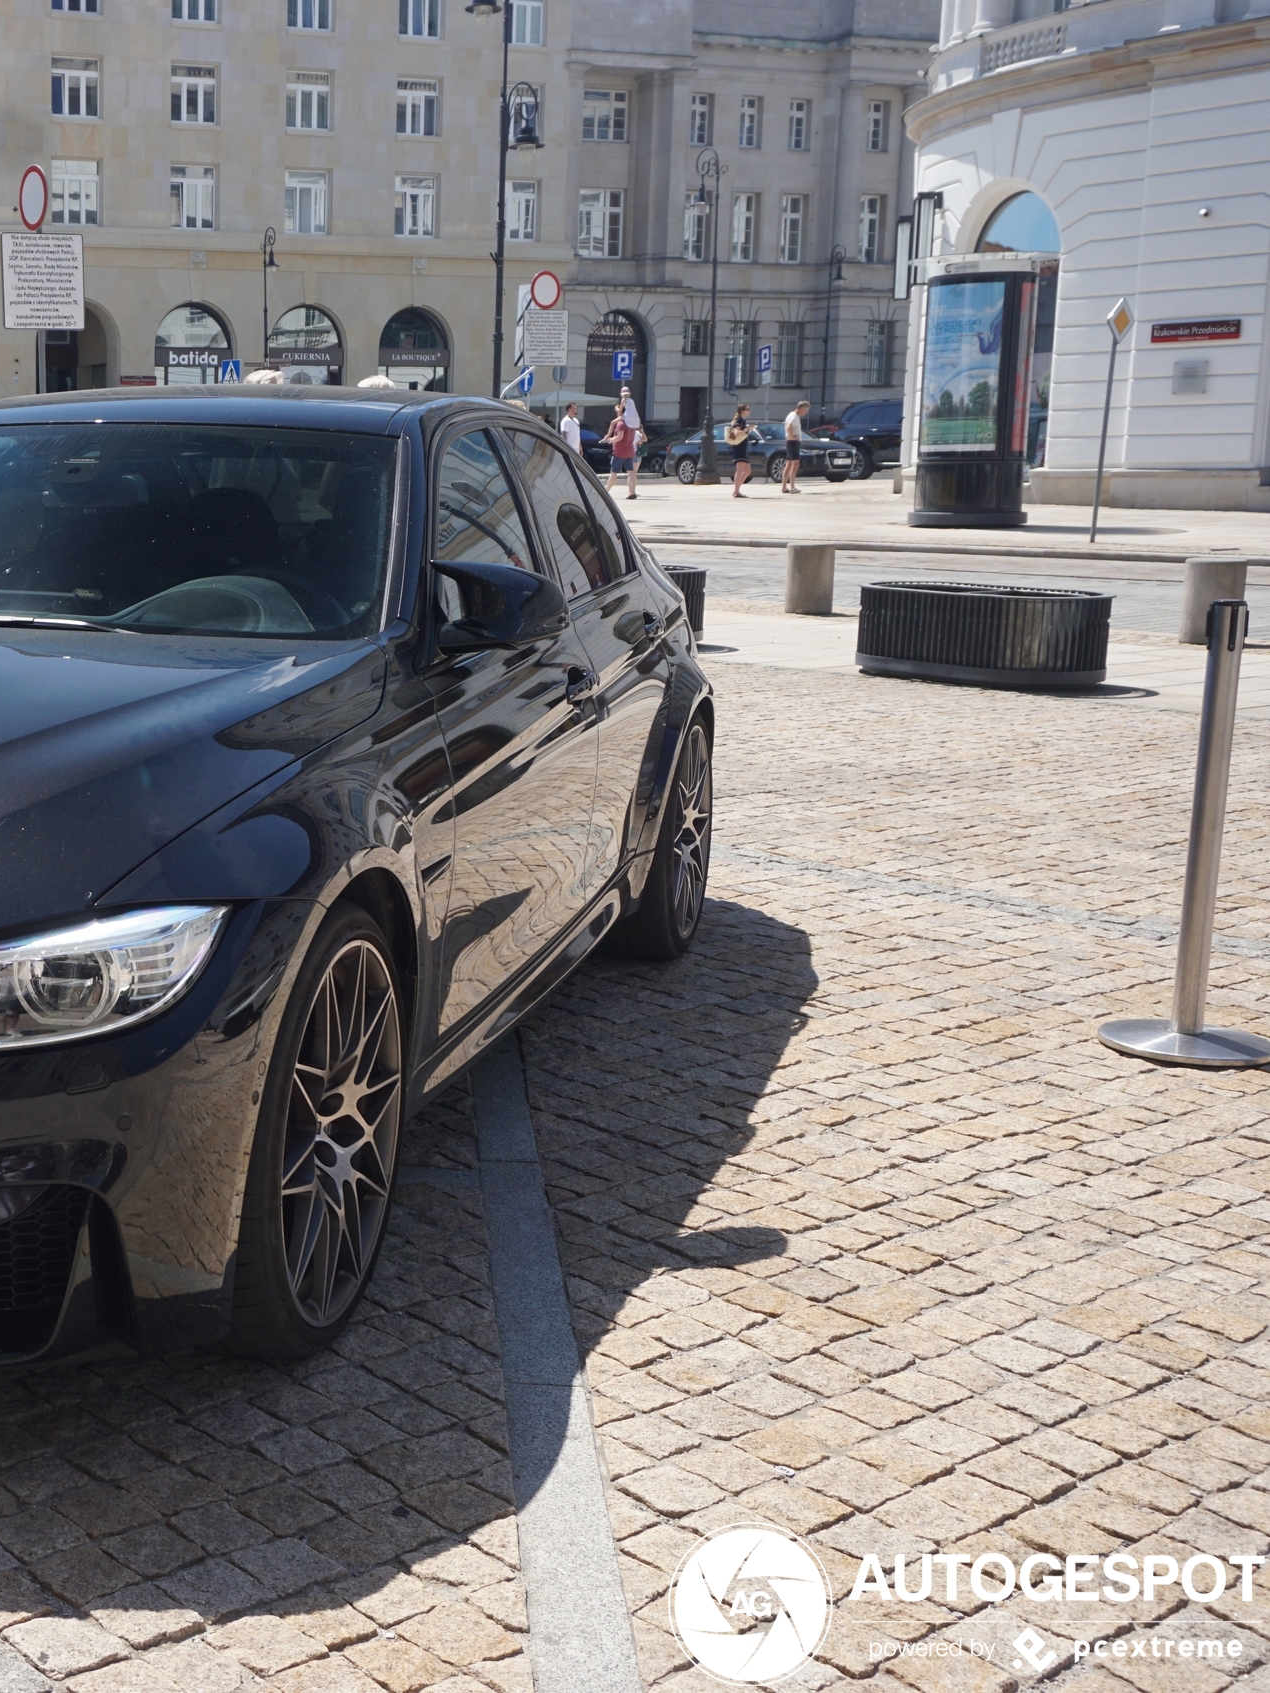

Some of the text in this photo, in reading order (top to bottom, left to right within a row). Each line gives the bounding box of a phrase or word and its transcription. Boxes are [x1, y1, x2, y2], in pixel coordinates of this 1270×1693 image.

[1153, 324, 1237, 337] Krakowskie Przedmieście
[169, 351, 218, 365] batida
[282, 352, 330, 361] CUKIERNIA
[617, 353, 629, 371] P
[761, 348, 770, 370] P
